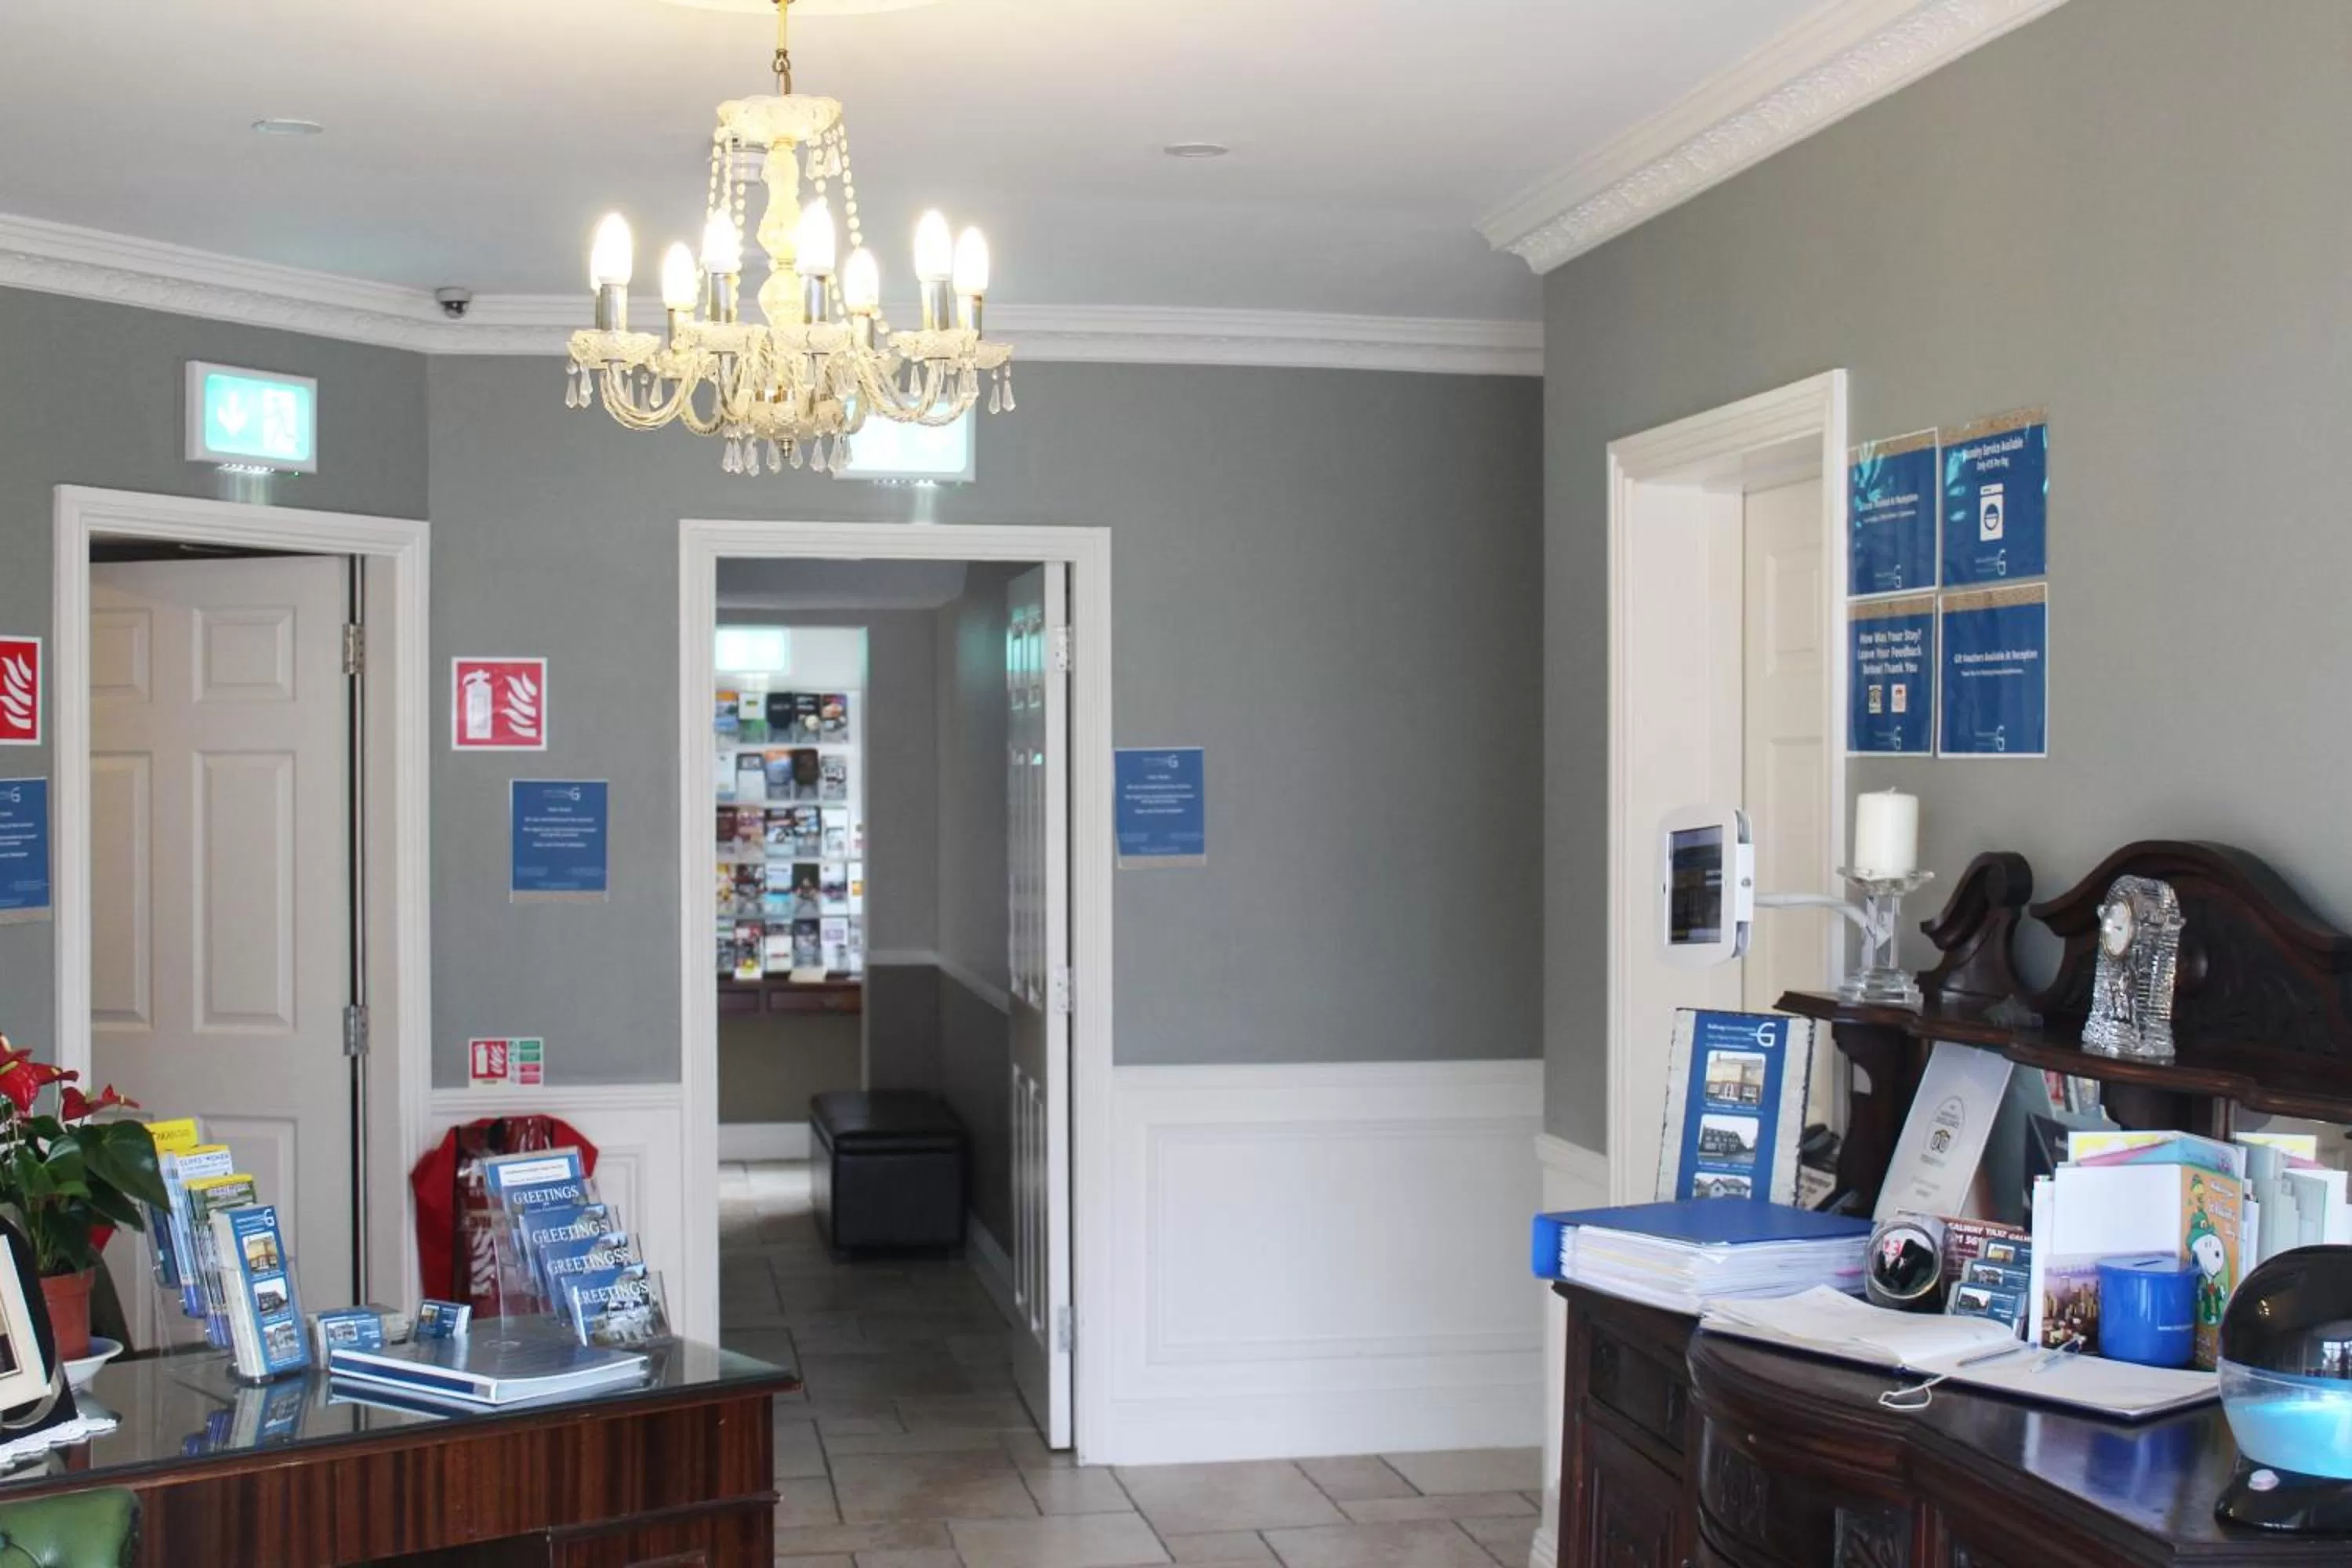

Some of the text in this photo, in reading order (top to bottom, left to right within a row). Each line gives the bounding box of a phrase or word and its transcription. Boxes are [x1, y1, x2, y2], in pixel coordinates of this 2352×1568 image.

[514, 1185, 579, 1204] GREETINGS
[532, 1220, 609, 1243] GREETINGS
[547, 1247, 626, 1274] GREETINGS
